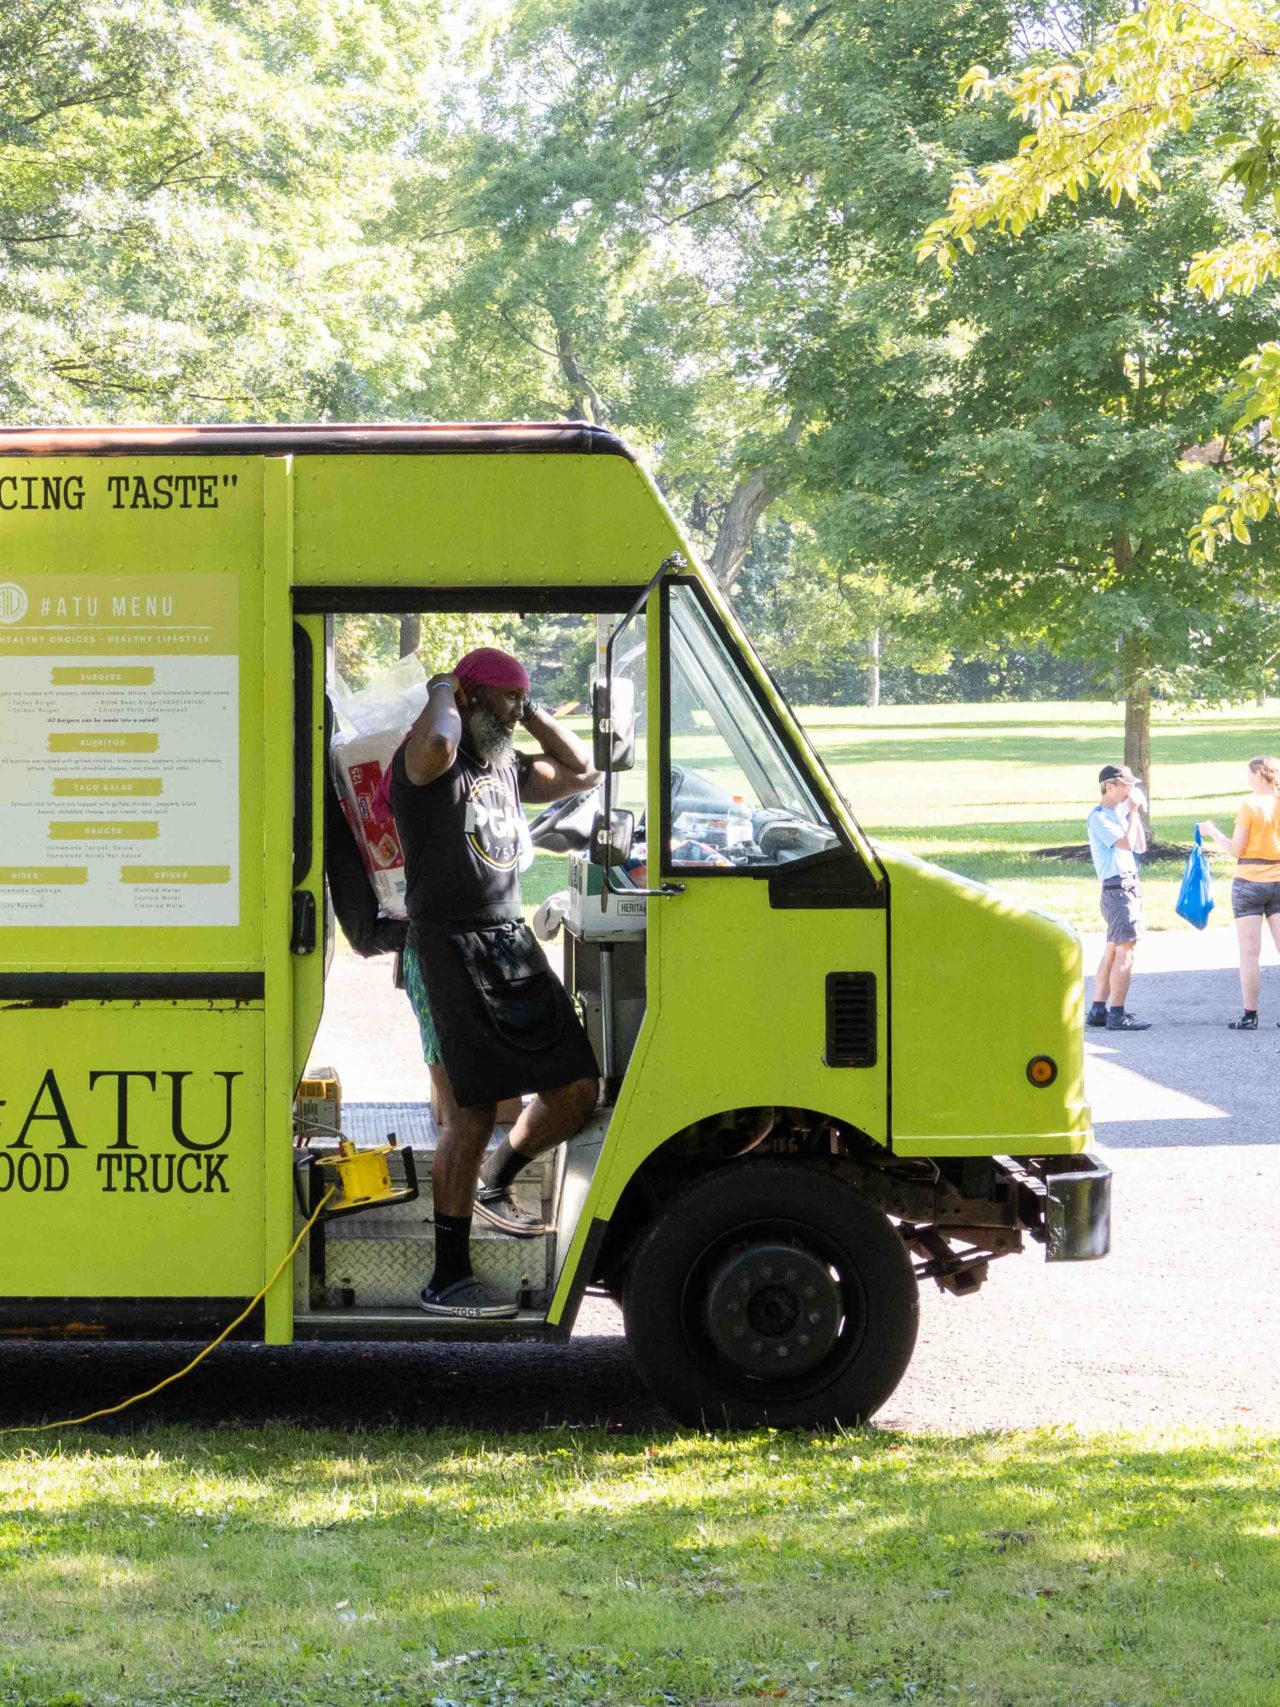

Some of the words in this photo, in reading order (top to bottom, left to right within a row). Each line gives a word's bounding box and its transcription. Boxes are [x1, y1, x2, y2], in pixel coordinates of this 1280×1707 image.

[107, 474, 238, 509] TASTE"
[41, 597, 98, 617] #ATU
[112, 597, 174, 617] MENU
[81, 673, 122, 681] BURGERS
[351, 767, 362, 785] 125
[96, 1152, 230, 1193] TRUCK
